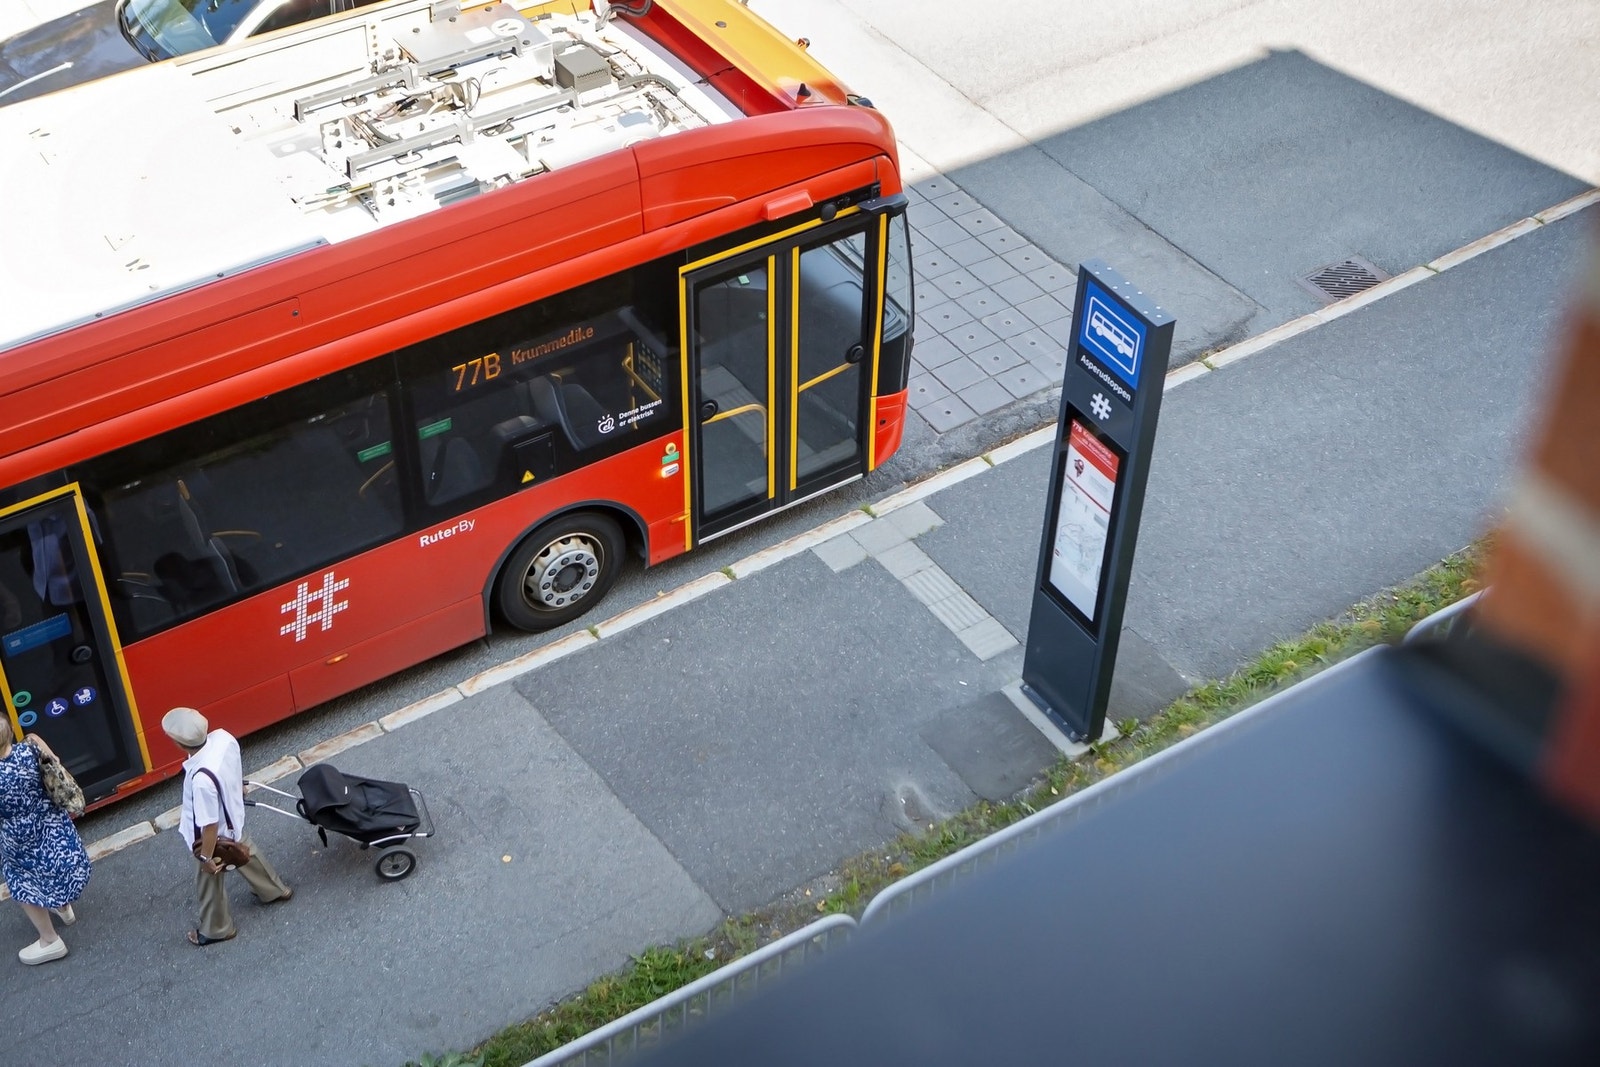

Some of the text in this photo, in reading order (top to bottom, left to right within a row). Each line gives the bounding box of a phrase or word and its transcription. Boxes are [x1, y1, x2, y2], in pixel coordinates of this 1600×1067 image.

[452, 327, 594, 391] 77B Krummedike
[1081, 355, 1131, 401] Asperudtoppen
[618, 399, 662, 419] Denne bussen
[627, 409, 654, 424] elektrisk
[419, 519, 475, 547] RuterBy
